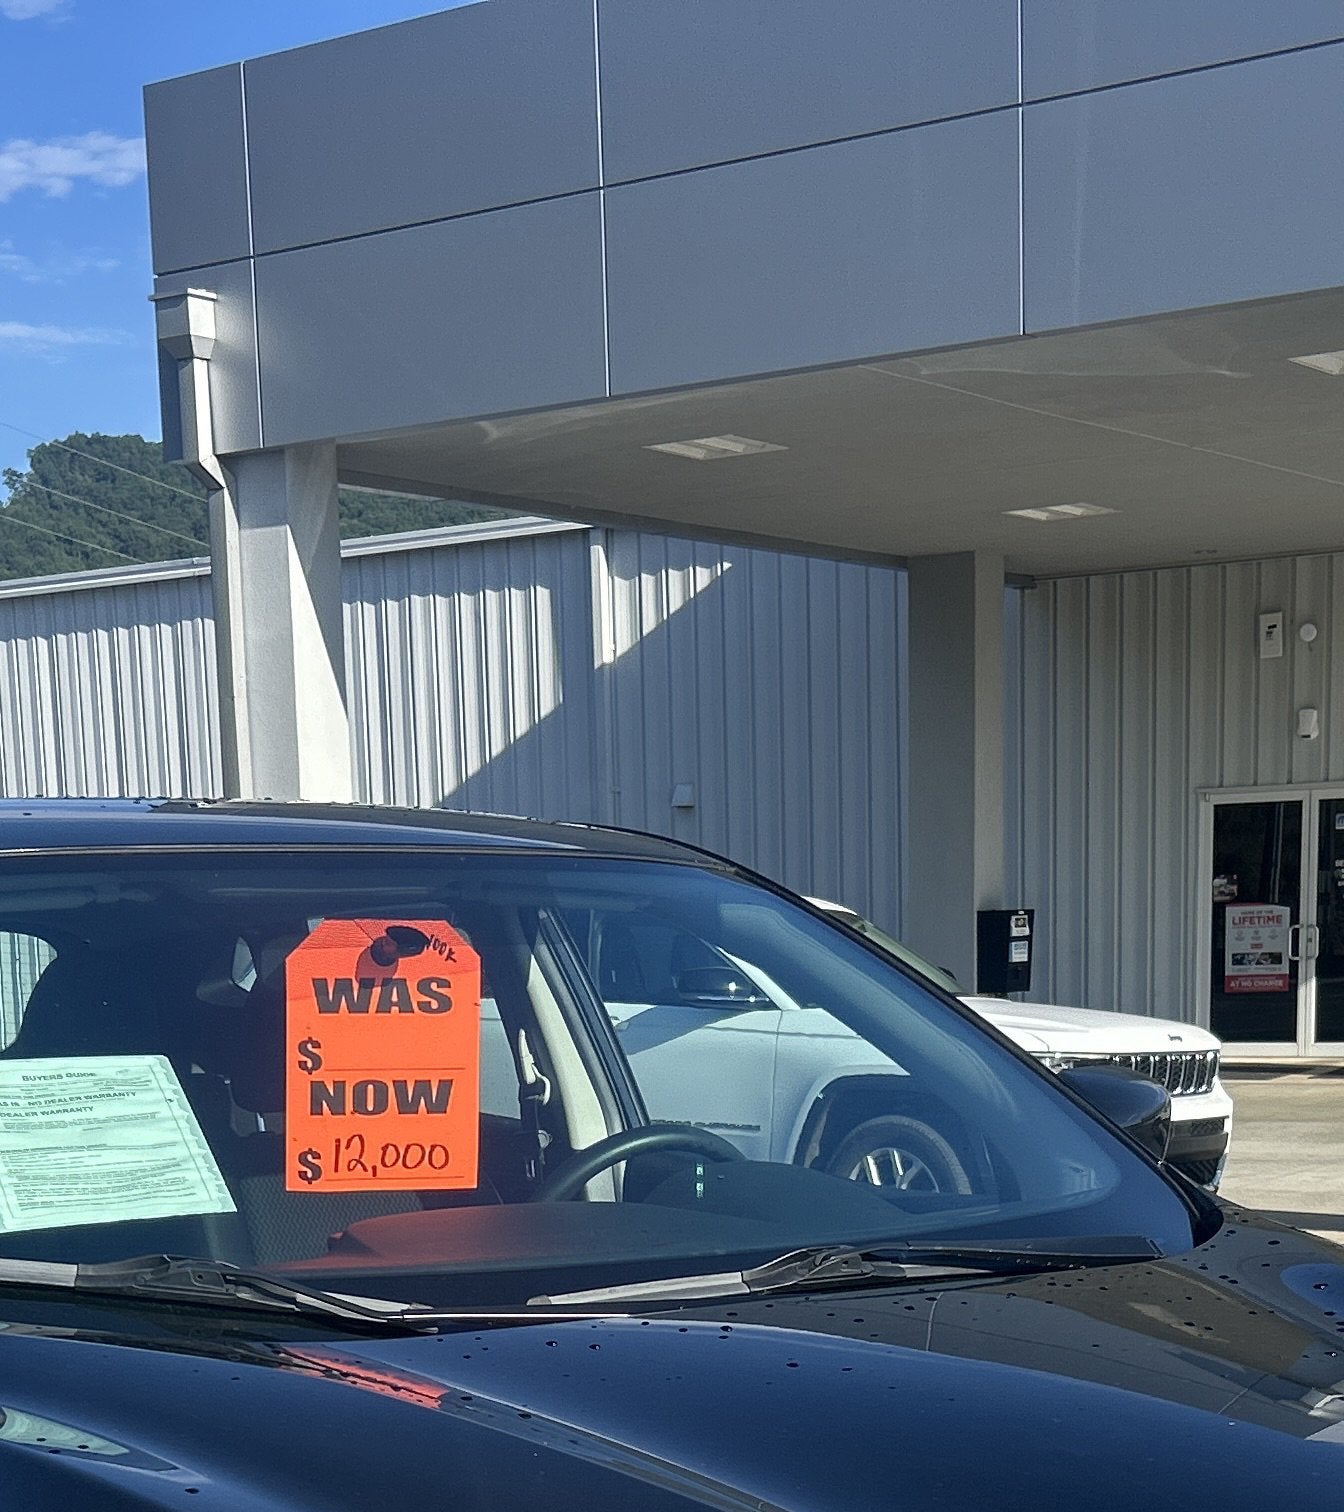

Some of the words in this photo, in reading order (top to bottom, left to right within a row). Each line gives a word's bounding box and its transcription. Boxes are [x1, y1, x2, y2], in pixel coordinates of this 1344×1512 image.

[1231, 914, 1283, 926] LIFETIME
[312, 976, 453, 1014] WAS
[297, 1036, 323, 1075] $
[22, 1073, 63, 1082] BUYERS
[44, 1096, 82, 1105] DEALER
[83, 1091, 137, 1101] WARRANTY
[309, 1079, 454, 1116] NOW
[40, 1106, 94, 1117] WARRANTY
[297, 1148, 323, 1184] $
[333, 1133, 450, 1178] 12,000
